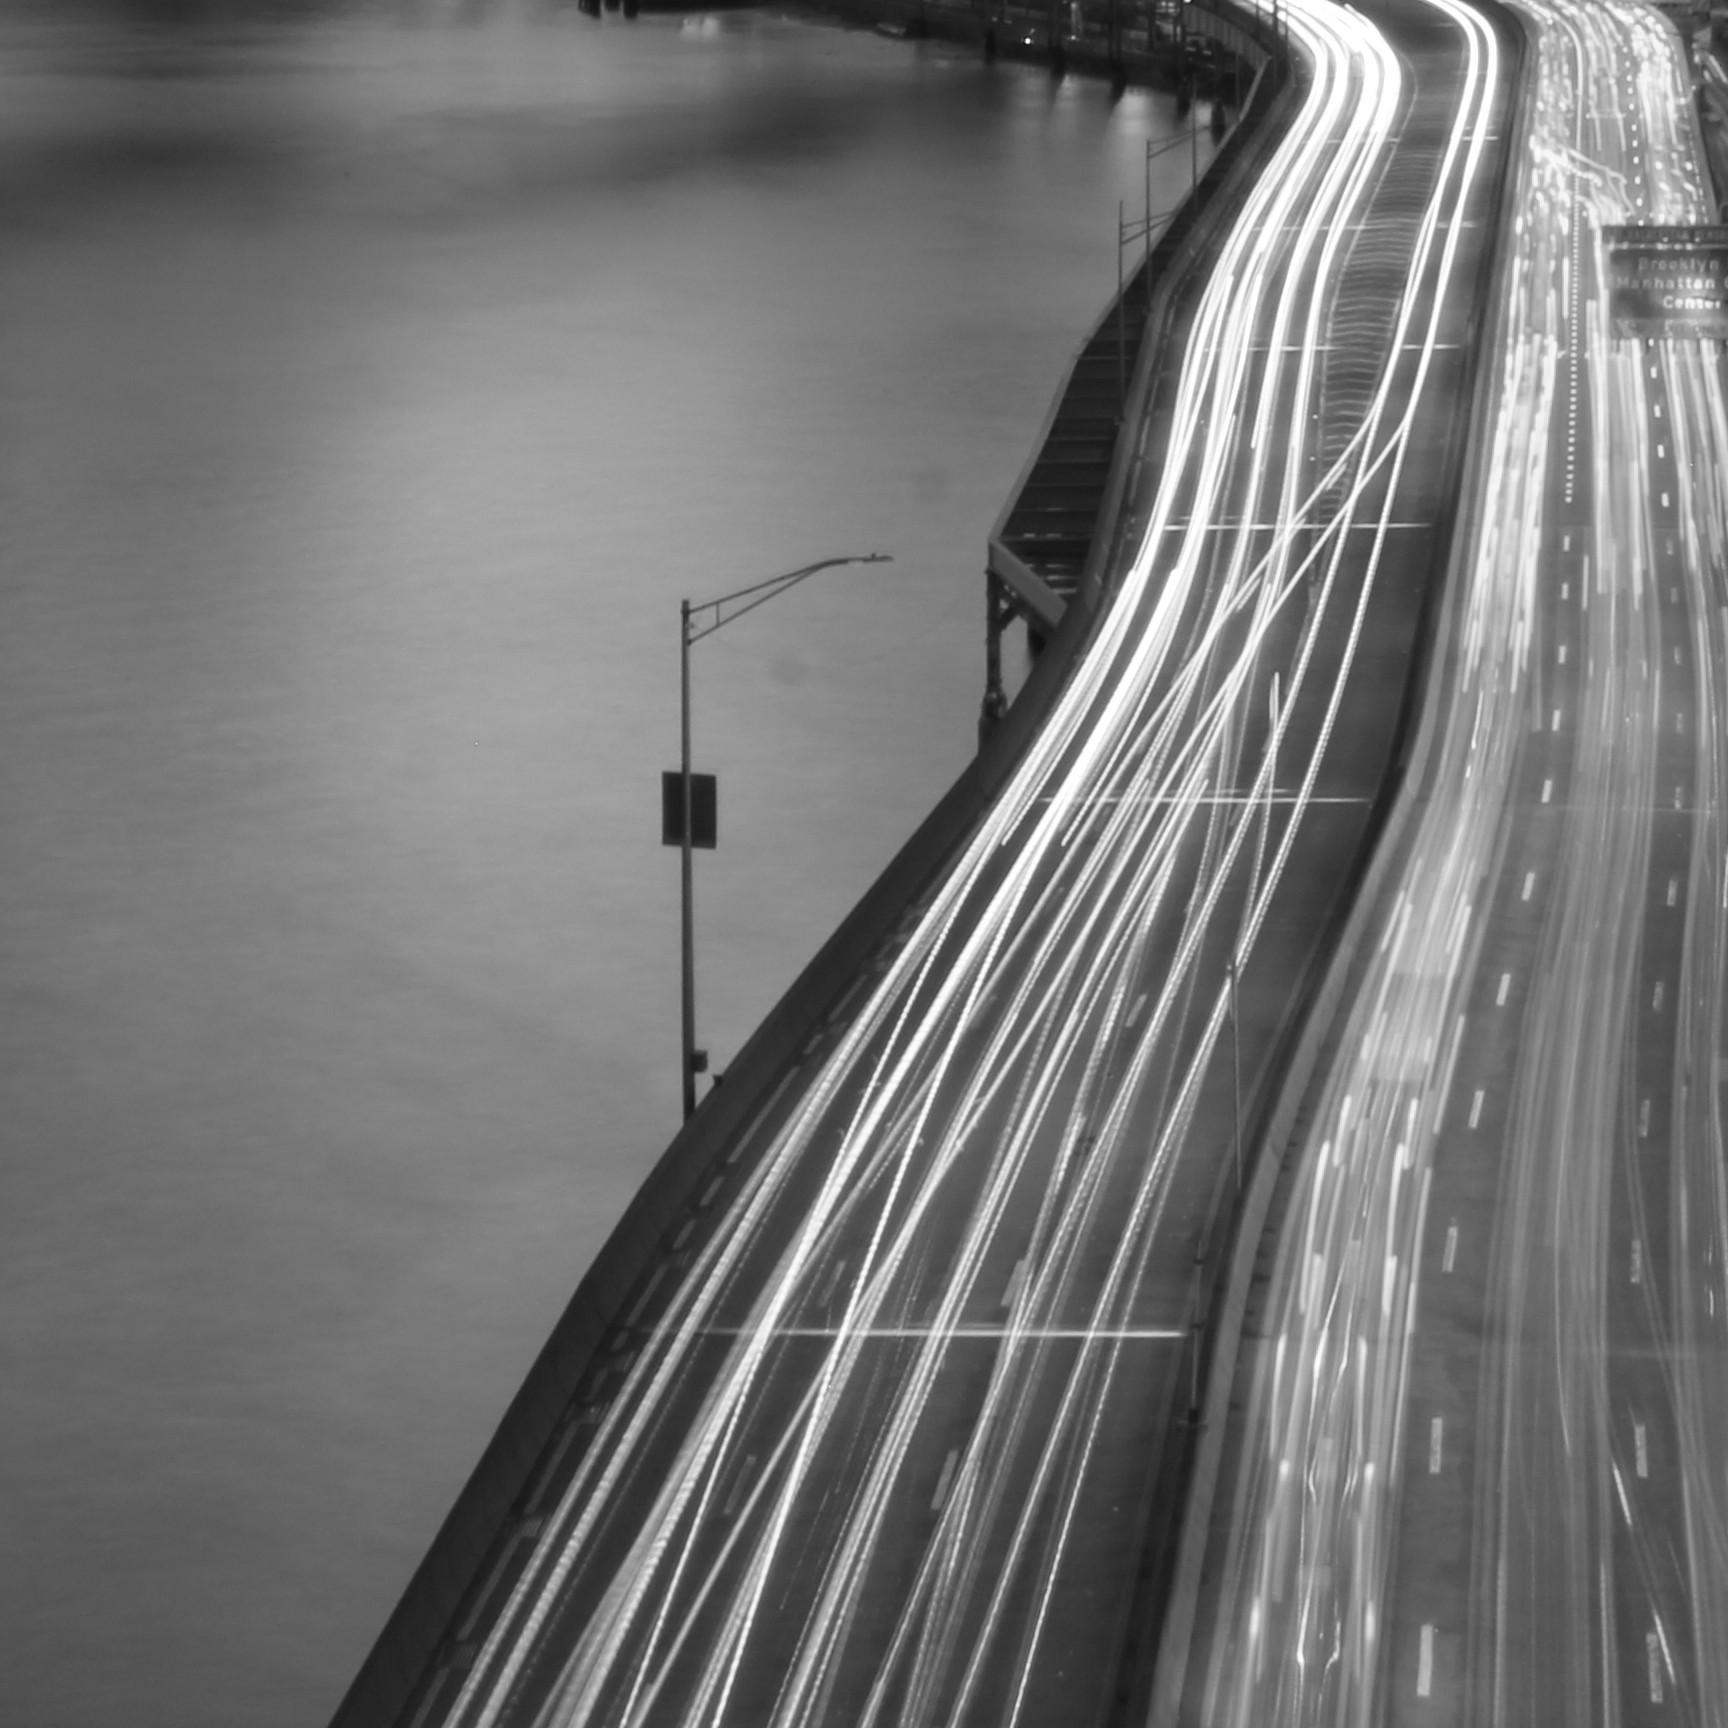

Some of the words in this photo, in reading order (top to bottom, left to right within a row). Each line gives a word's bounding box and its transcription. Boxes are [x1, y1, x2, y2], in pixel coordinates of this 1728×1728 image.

[1638, 256, 1719, 273] Brooklyn
[1616, 276, 1716, 290] Manhattan
[1663, 295, 1721, 310] Center
